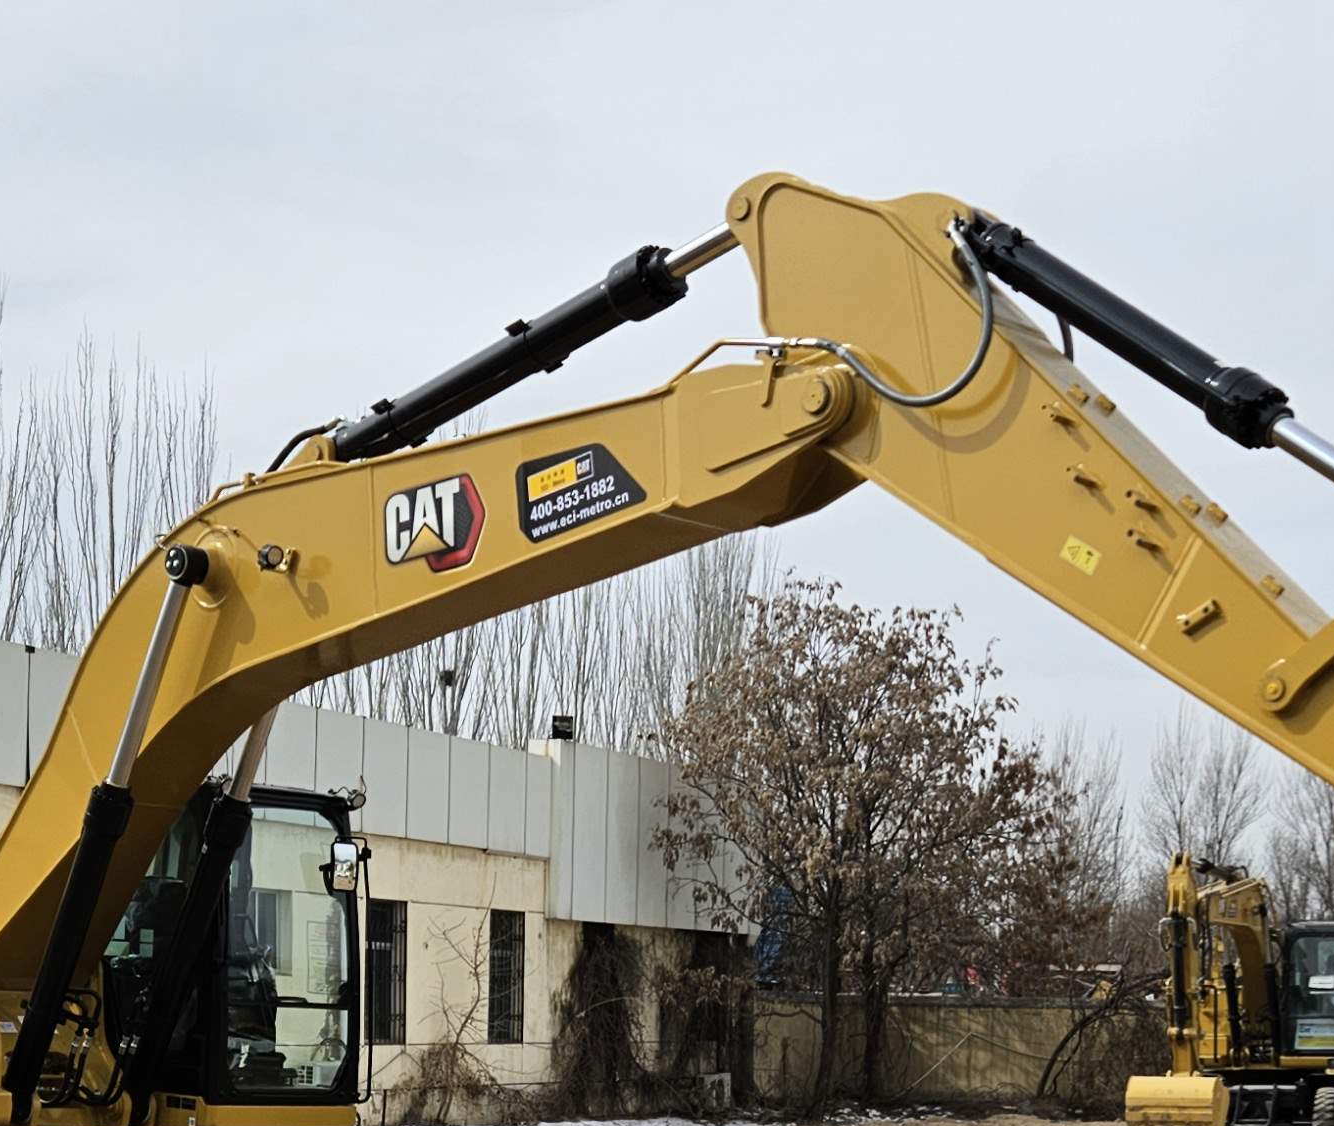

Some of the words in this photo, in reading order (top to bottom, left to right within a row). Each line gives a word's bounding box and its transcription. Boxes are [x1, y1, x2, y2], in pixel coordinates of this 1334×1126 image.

[385, 477, 460, 562] CAT
[530, 475, 615, 521] 400-853-1882
[531, 492, 630, 538] www.eci-metro.cn
